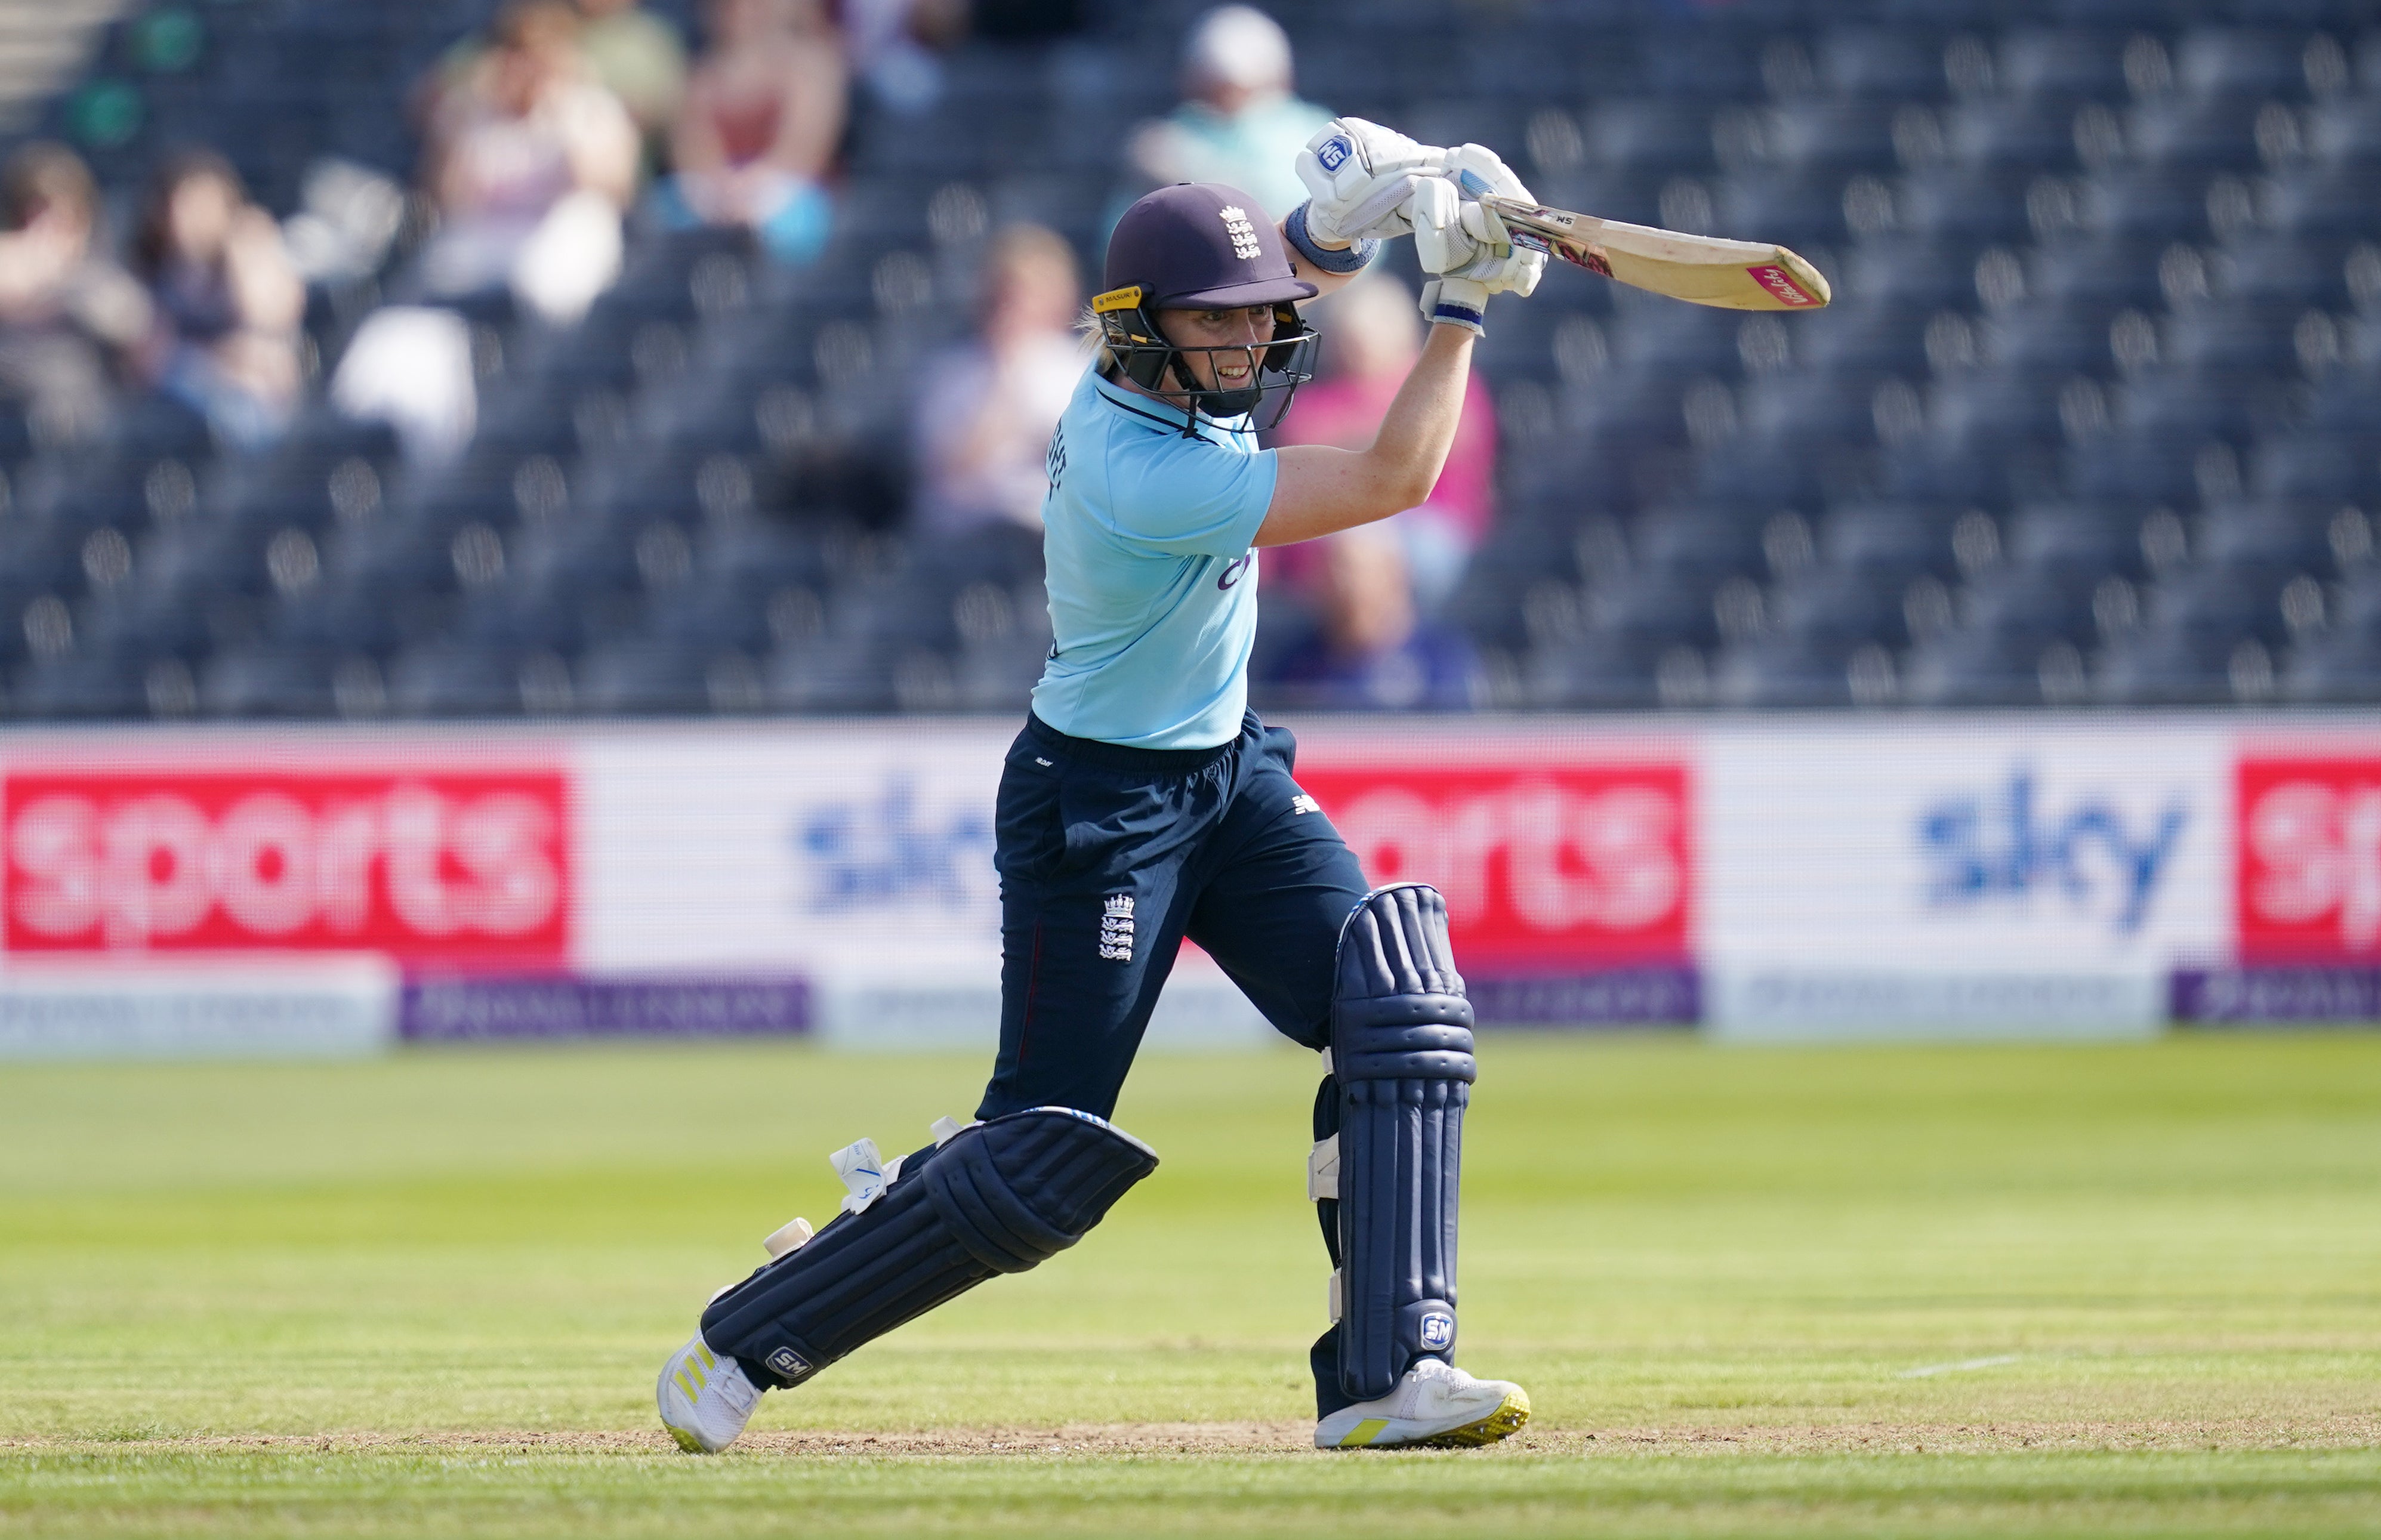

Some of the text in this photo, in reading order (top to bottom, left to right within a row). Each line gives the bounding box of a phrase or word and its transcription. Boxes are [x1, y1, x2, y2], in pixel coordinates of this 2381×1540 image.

[1764, 269, 1808, 303] Vitality
[11, 783, 560, 950] sports
[1336, 779, 1683, 933] orts
[1917, 757, 2189, 933] sky
[775, 1353, 807, 1375] SM
[1424, 1319, 1451, 1341] SM
